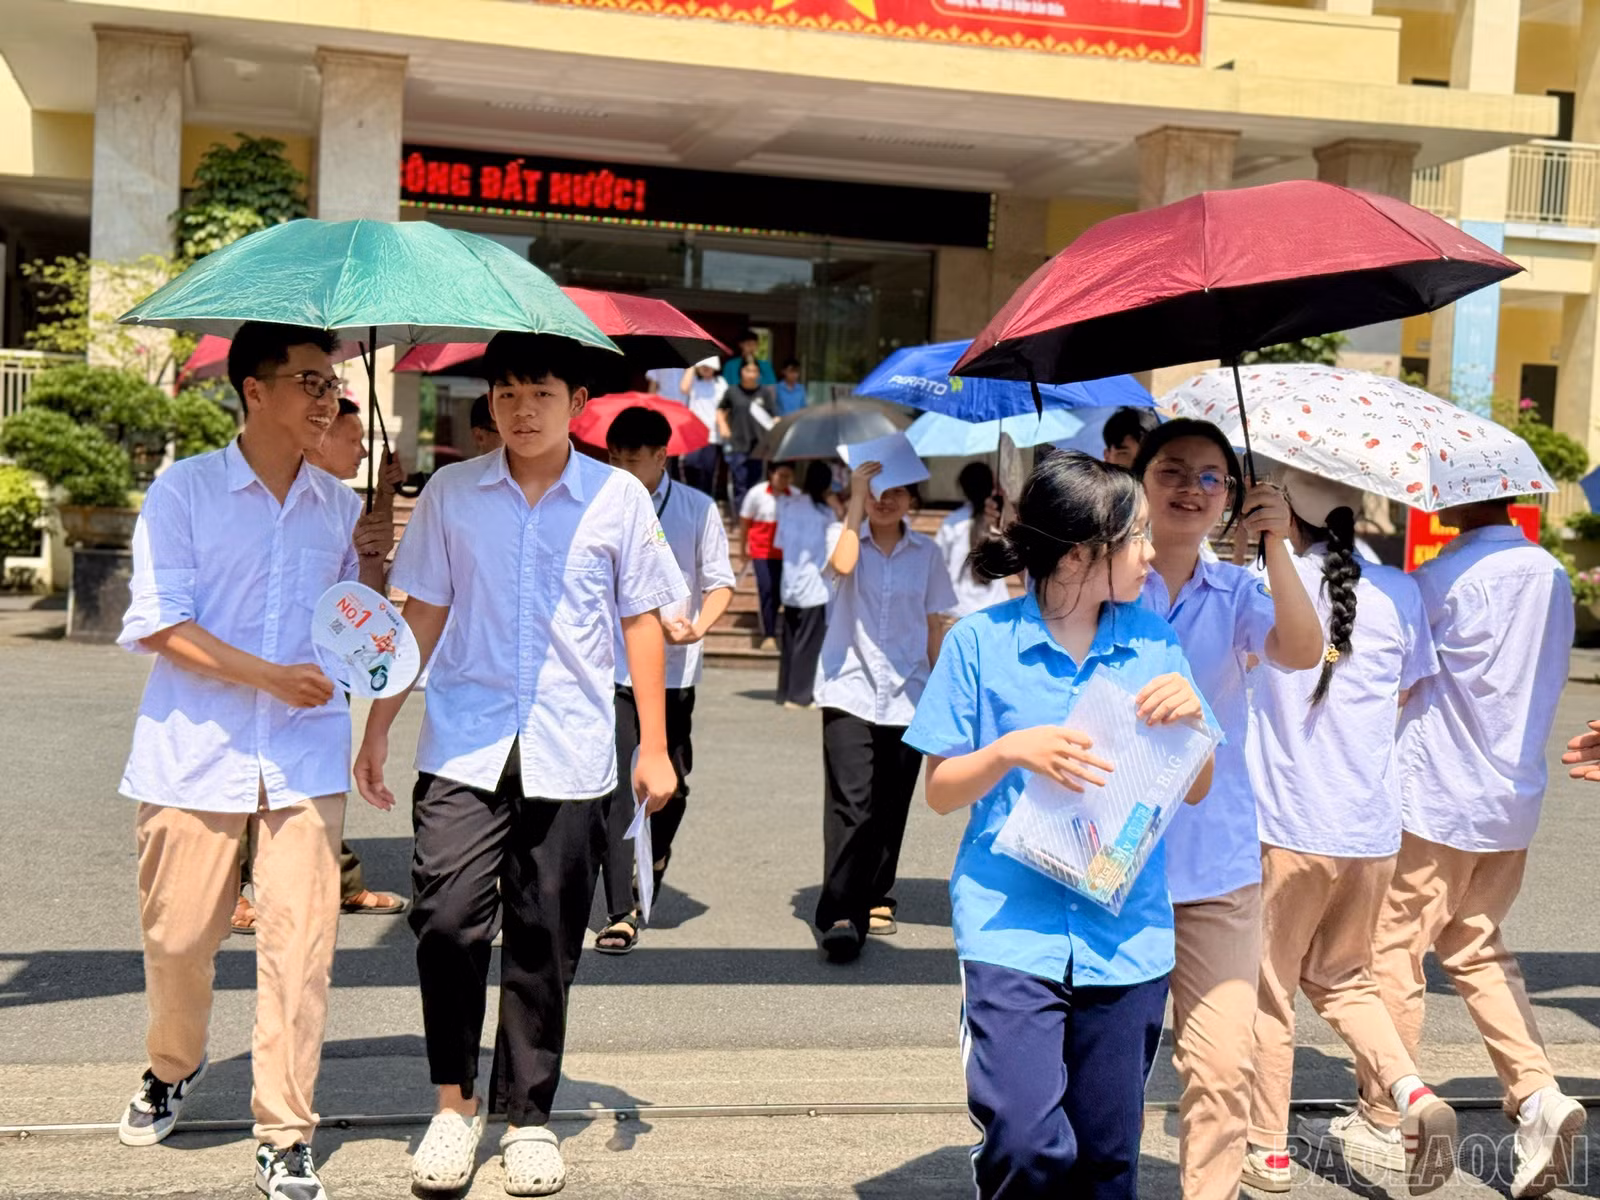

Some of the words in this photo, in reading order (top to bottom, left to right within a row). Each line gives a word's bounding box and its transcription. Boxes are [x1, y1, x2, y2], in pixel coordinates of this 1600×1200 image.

[398, 152, 471, 197] ÔNG
[480, 158, 542, 203] ĐẤT
[549, 169, 646, 212] NƯỚC!
[1156, 754, 1182, 788] BAG
